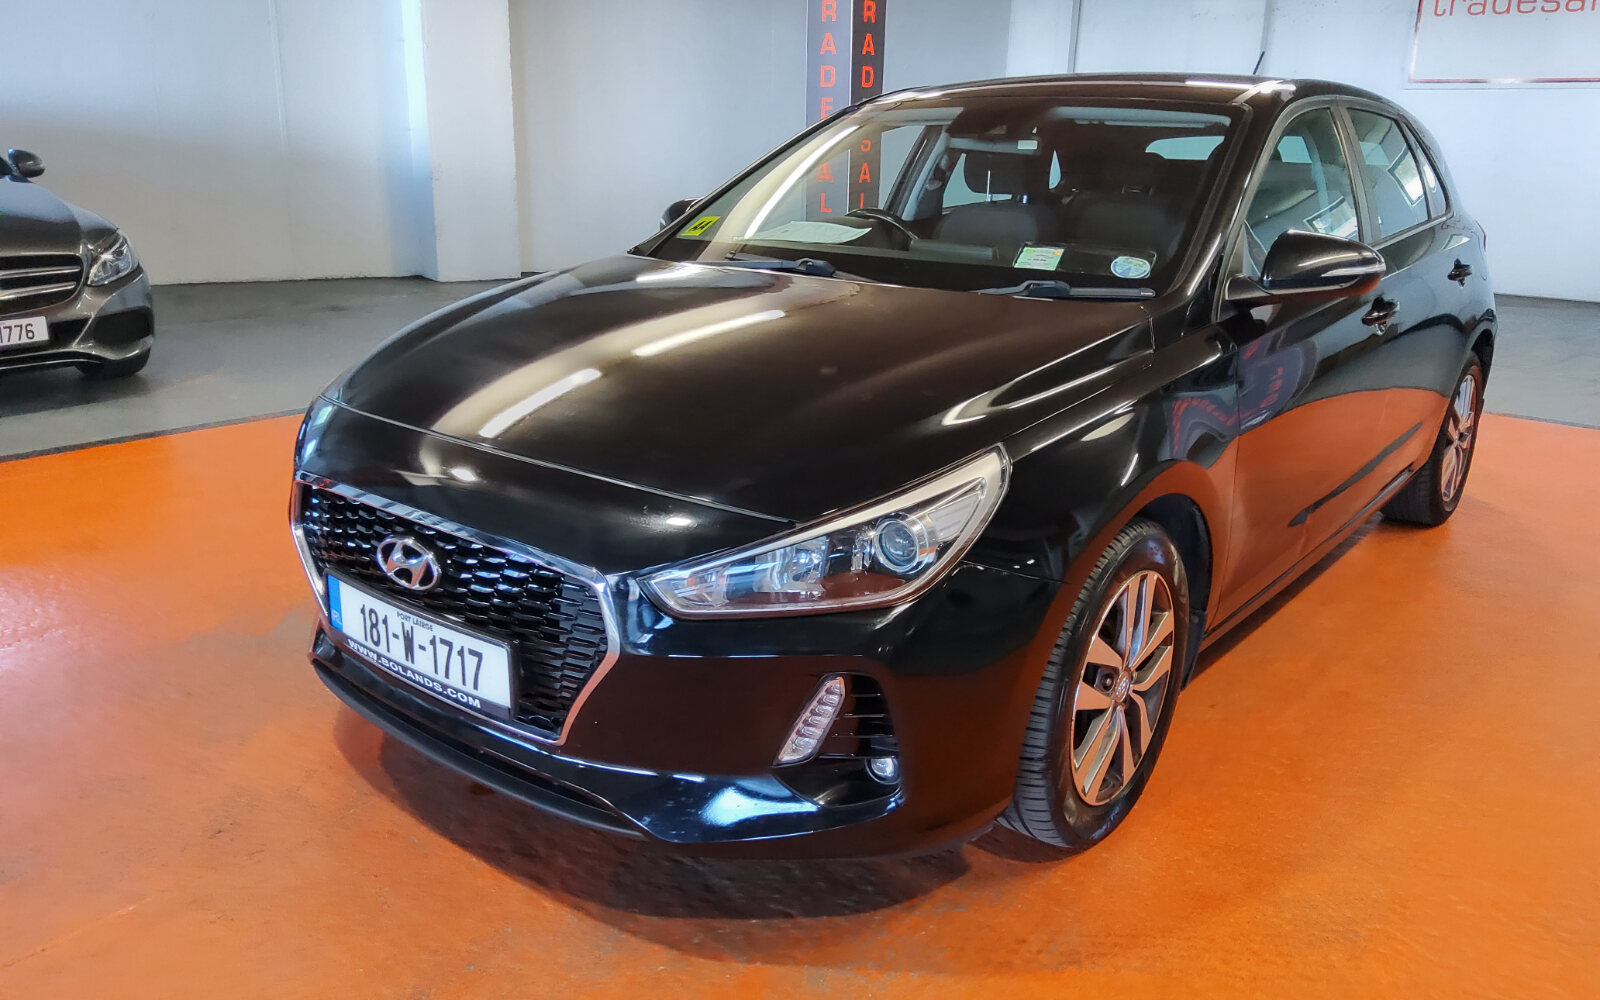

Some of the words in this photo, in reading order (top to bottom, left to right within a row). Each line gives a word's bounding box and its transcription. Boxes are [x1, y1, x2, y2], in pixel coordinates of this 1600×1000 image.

[360, 603, 483, 691] 181-W-1717
[397, 611, 412, 625] PORT
[347, 638, 481, 709] WWW.BOLANDS.COM
